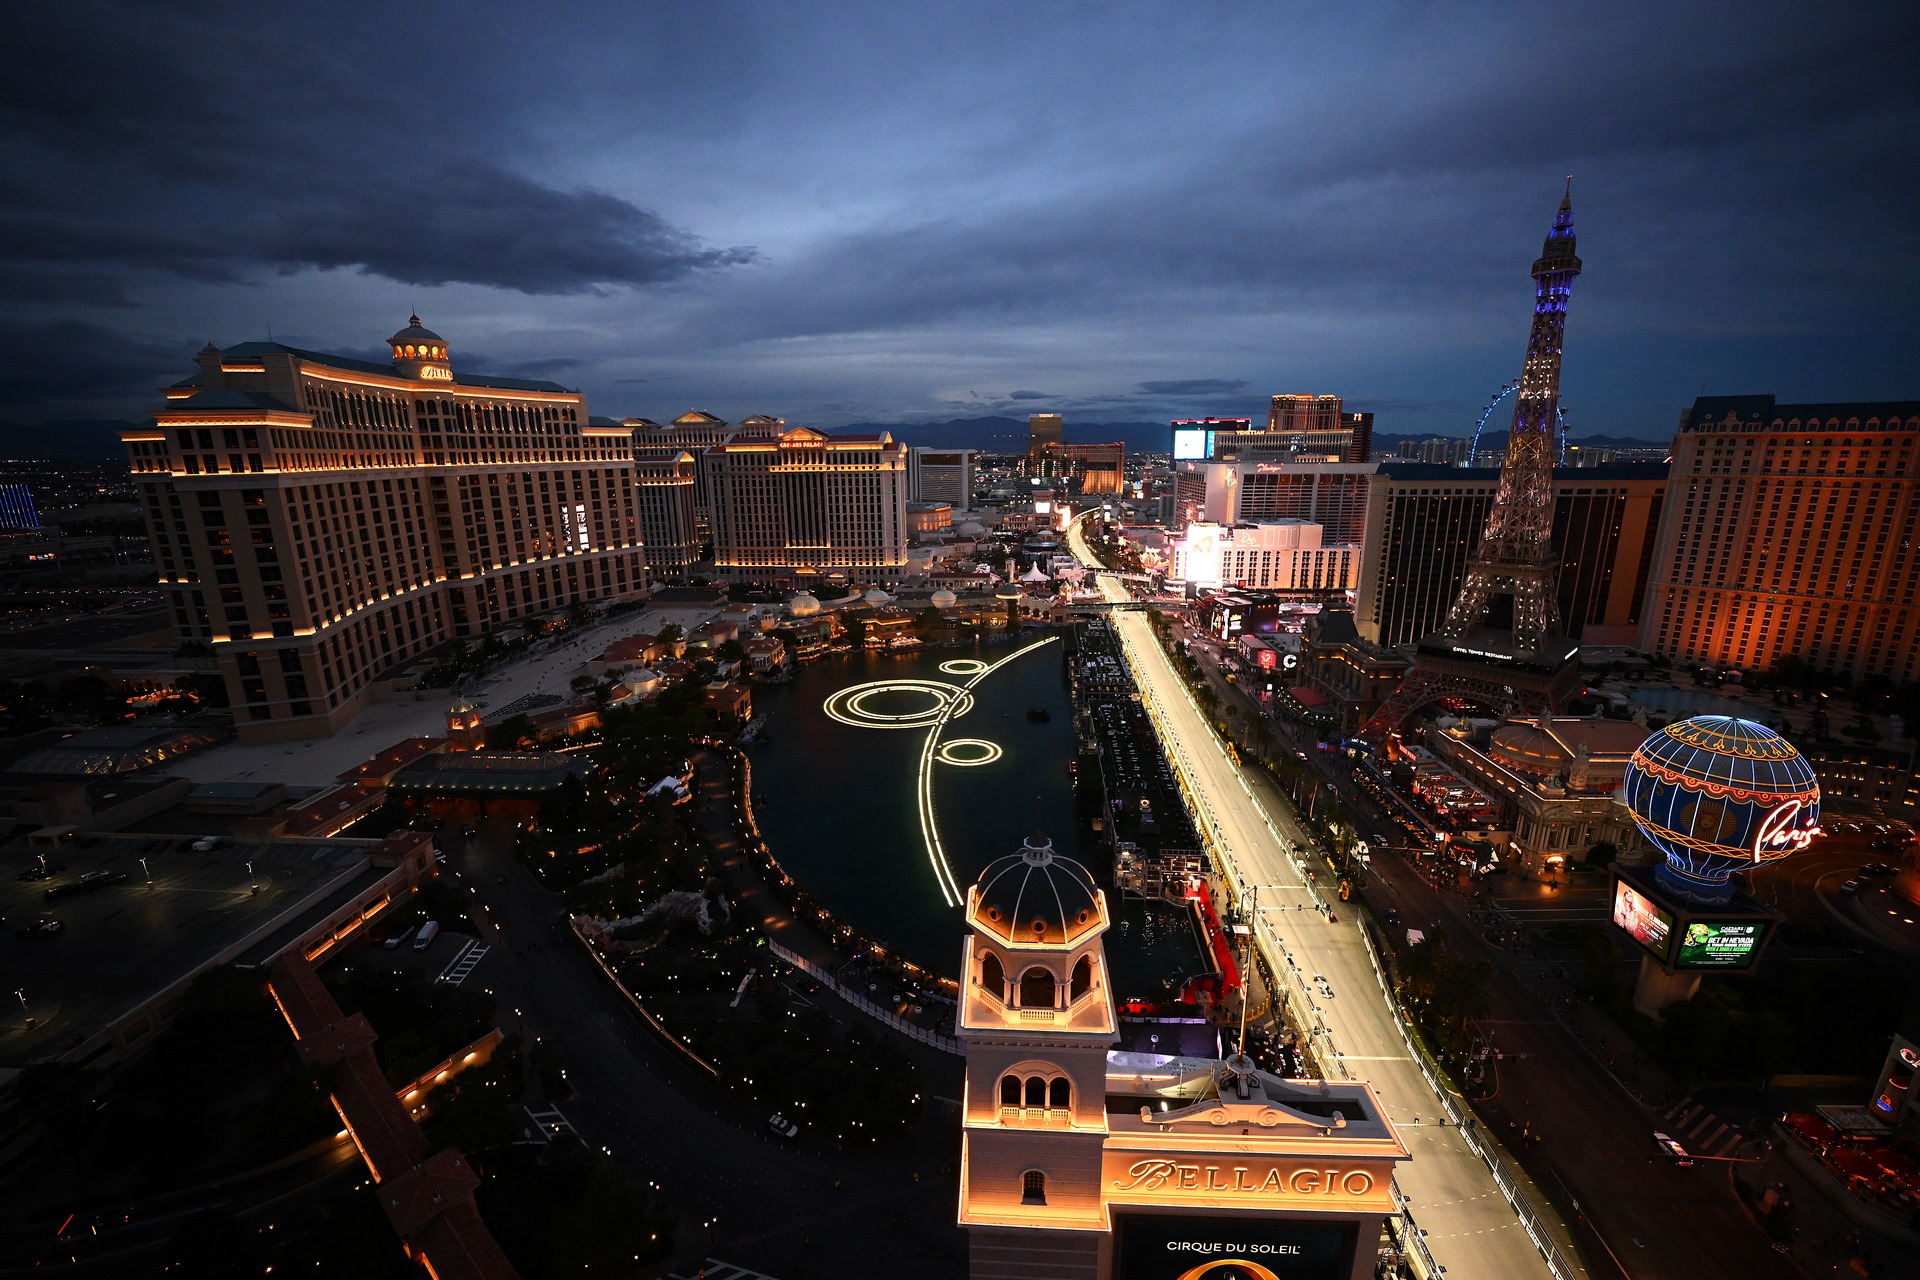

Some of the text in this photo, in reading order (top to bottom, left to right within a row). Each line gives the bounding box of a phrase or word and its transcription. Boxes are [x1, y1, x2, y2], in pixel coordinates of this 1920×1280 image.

[1484, 652, 1513, 660] RESTAURANT
[1755, 799, 1821, 863] Paris
[1113, 1159, 1374, 1195] BELLAGIO
[1166, 1241, 1301, 1255] CIRQUE DU SOLEIL
